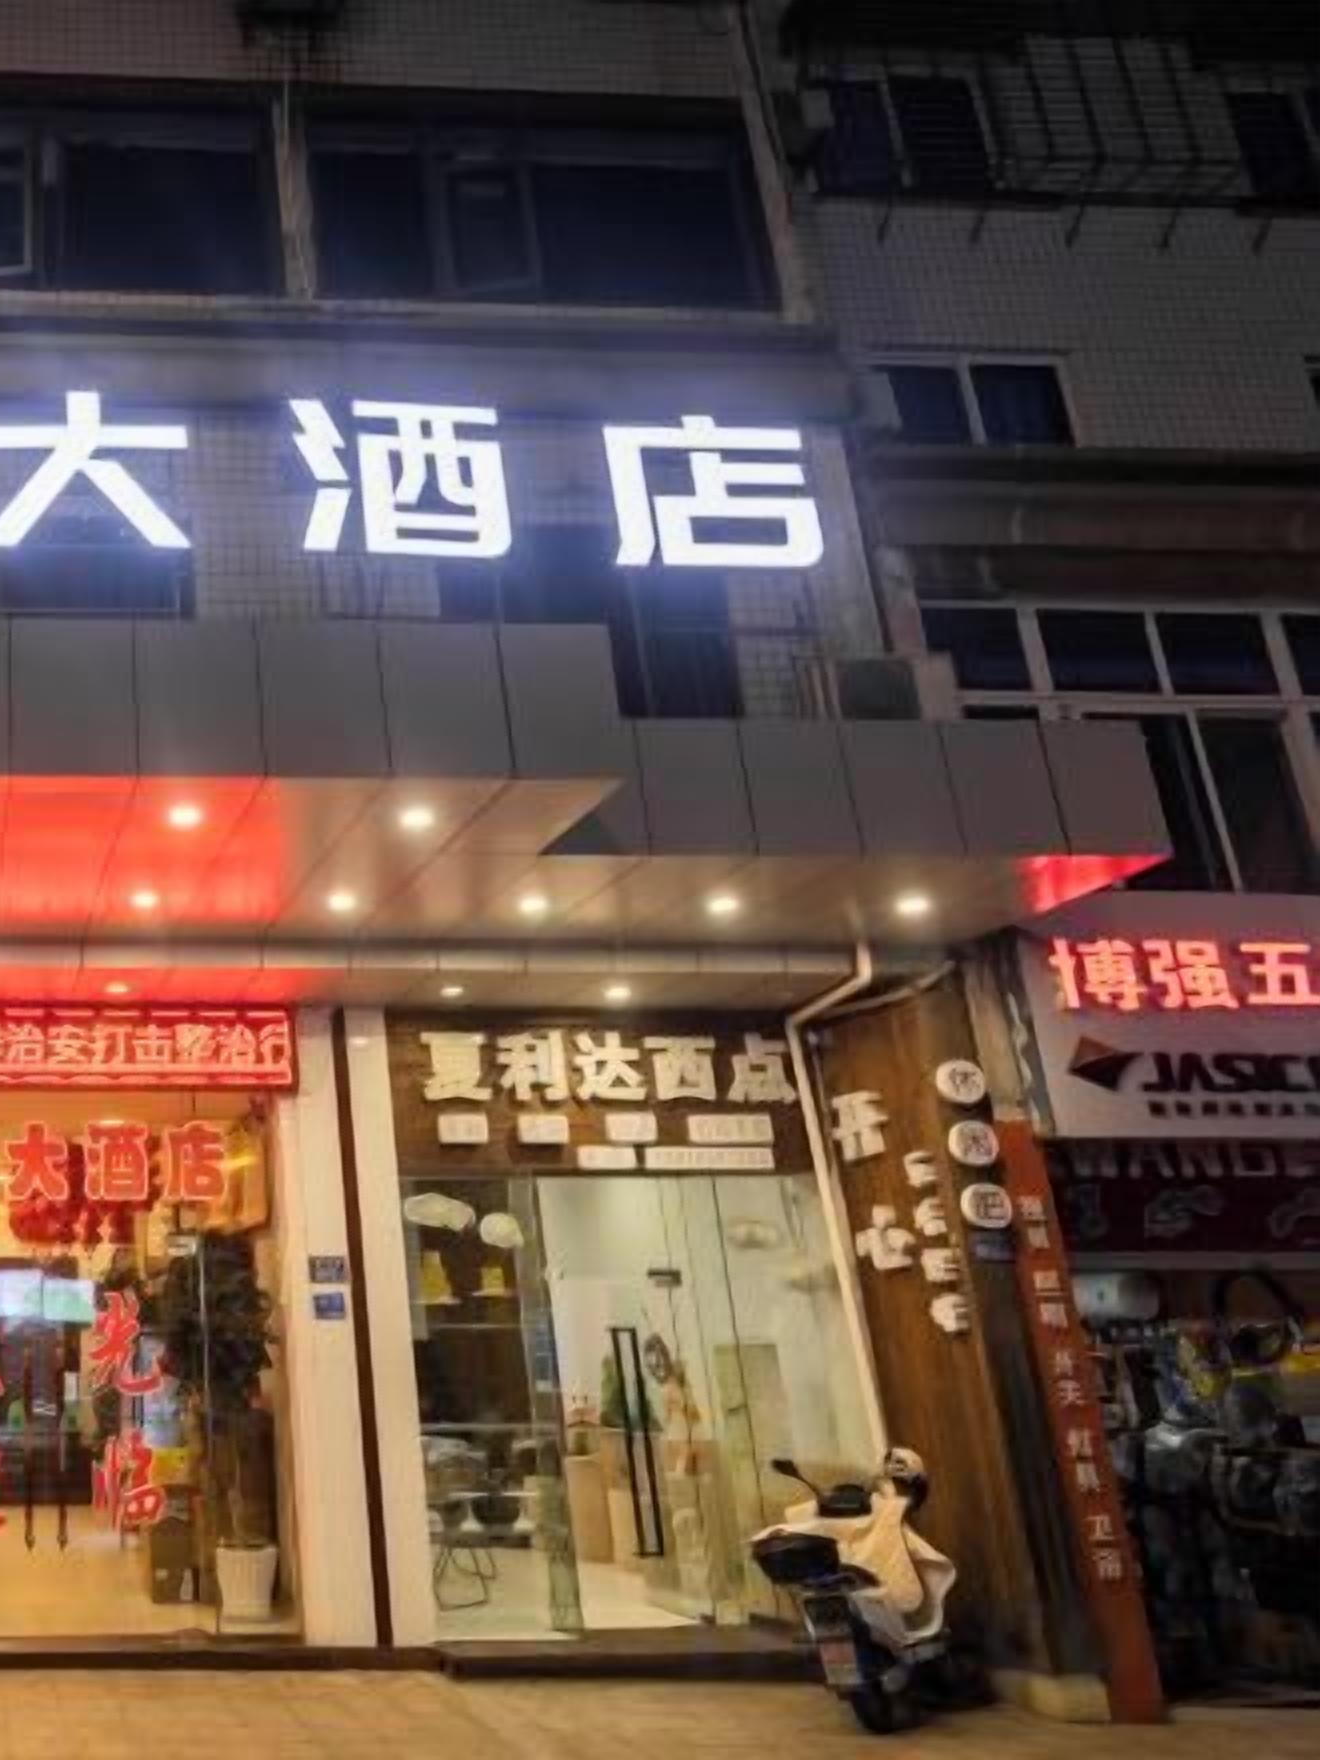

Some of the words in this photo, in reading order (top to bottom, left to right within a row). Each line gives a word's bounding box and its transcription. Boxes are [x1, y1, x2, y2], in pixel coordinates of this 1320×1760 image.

[420, 1029, 799, 1104] 夏利达西点
